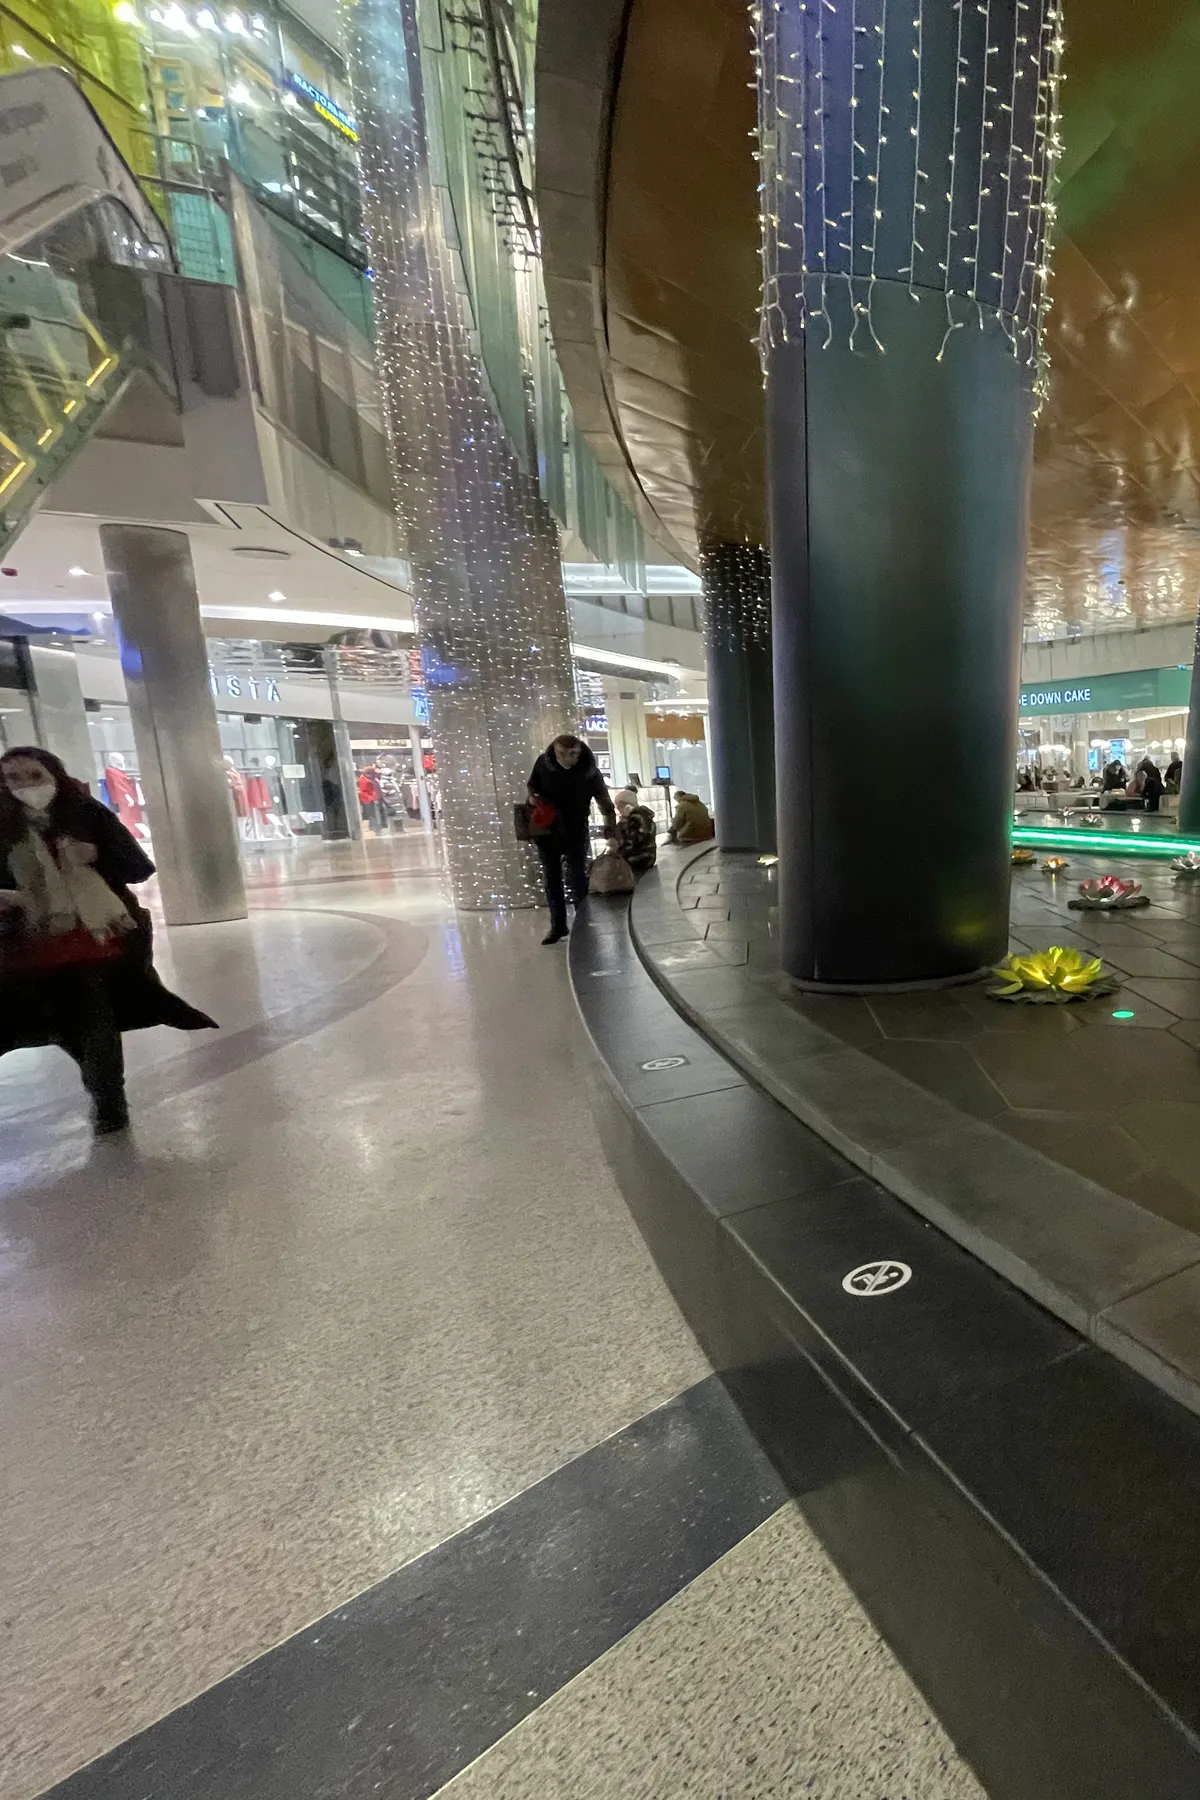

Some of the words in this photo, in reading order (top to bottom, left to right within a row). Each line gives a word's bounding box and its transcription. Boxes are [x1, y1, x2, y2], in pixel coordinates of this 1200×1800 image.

[1018, 694, 1028, 707] E
[1030, 691, 1062, 706] DOWN
[1064, 688, 1091, 703] CAKE
